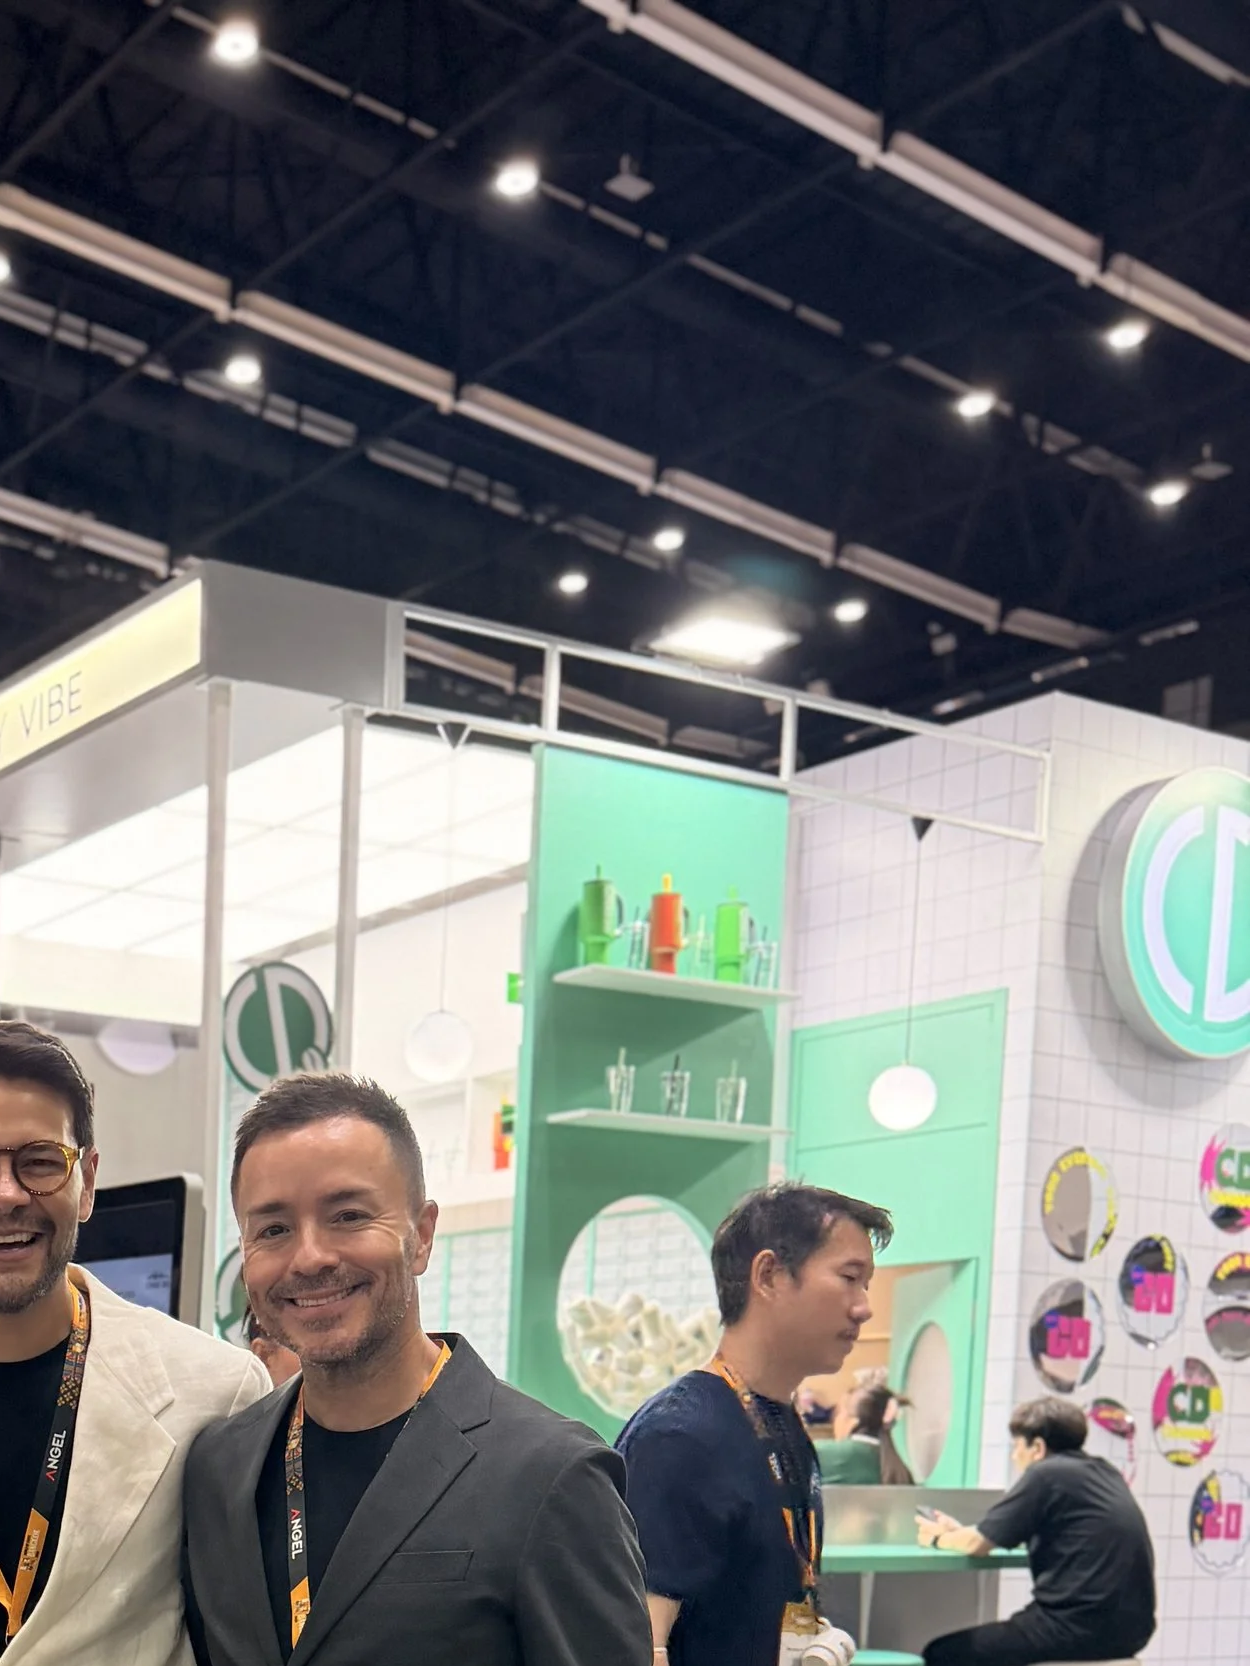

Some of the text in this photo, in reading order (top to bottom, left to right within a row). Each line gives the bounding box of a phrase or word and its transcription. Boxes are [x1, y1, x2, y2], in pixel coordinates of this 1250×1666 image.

[18, 670, 82, 738] VIBE
[46, 1430, 67, 1482] ANGEL
[290, 1508, 303, 1560] ANGEL
